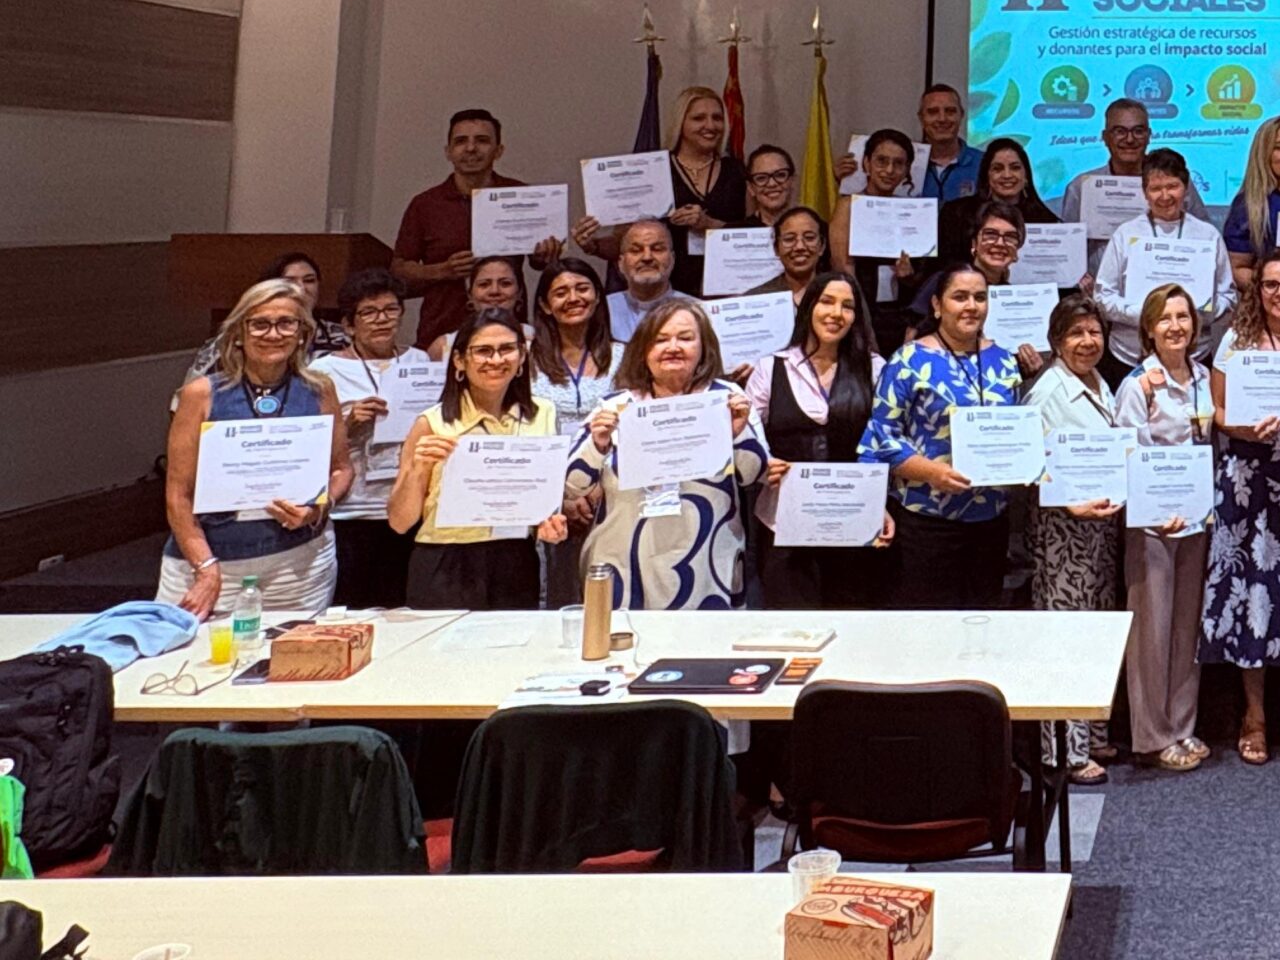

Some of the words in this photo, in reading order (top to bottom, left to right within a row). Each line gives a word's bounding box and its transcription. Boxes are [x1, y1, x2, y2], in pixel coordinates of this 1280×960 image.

[1049, 25, 1100, 39] Gestión
[1103, 25, 1176, 43] estratégica
[1178, 25, 1197, 39] de
[1200, 28, 1257, 39] recursos
[1037, 45, 1046, 59] y
[1049, 42, 1112, 56] donantes
[1115, 44, 1146, 59] para
[1149, 42, 1161, 56] el
[1164, 42, 1223, 59] impacto
[1226, 42, 1267, 56] social
[241, 439, 292, 448] Certificado
[483, 456, 532, 465] Certificado
